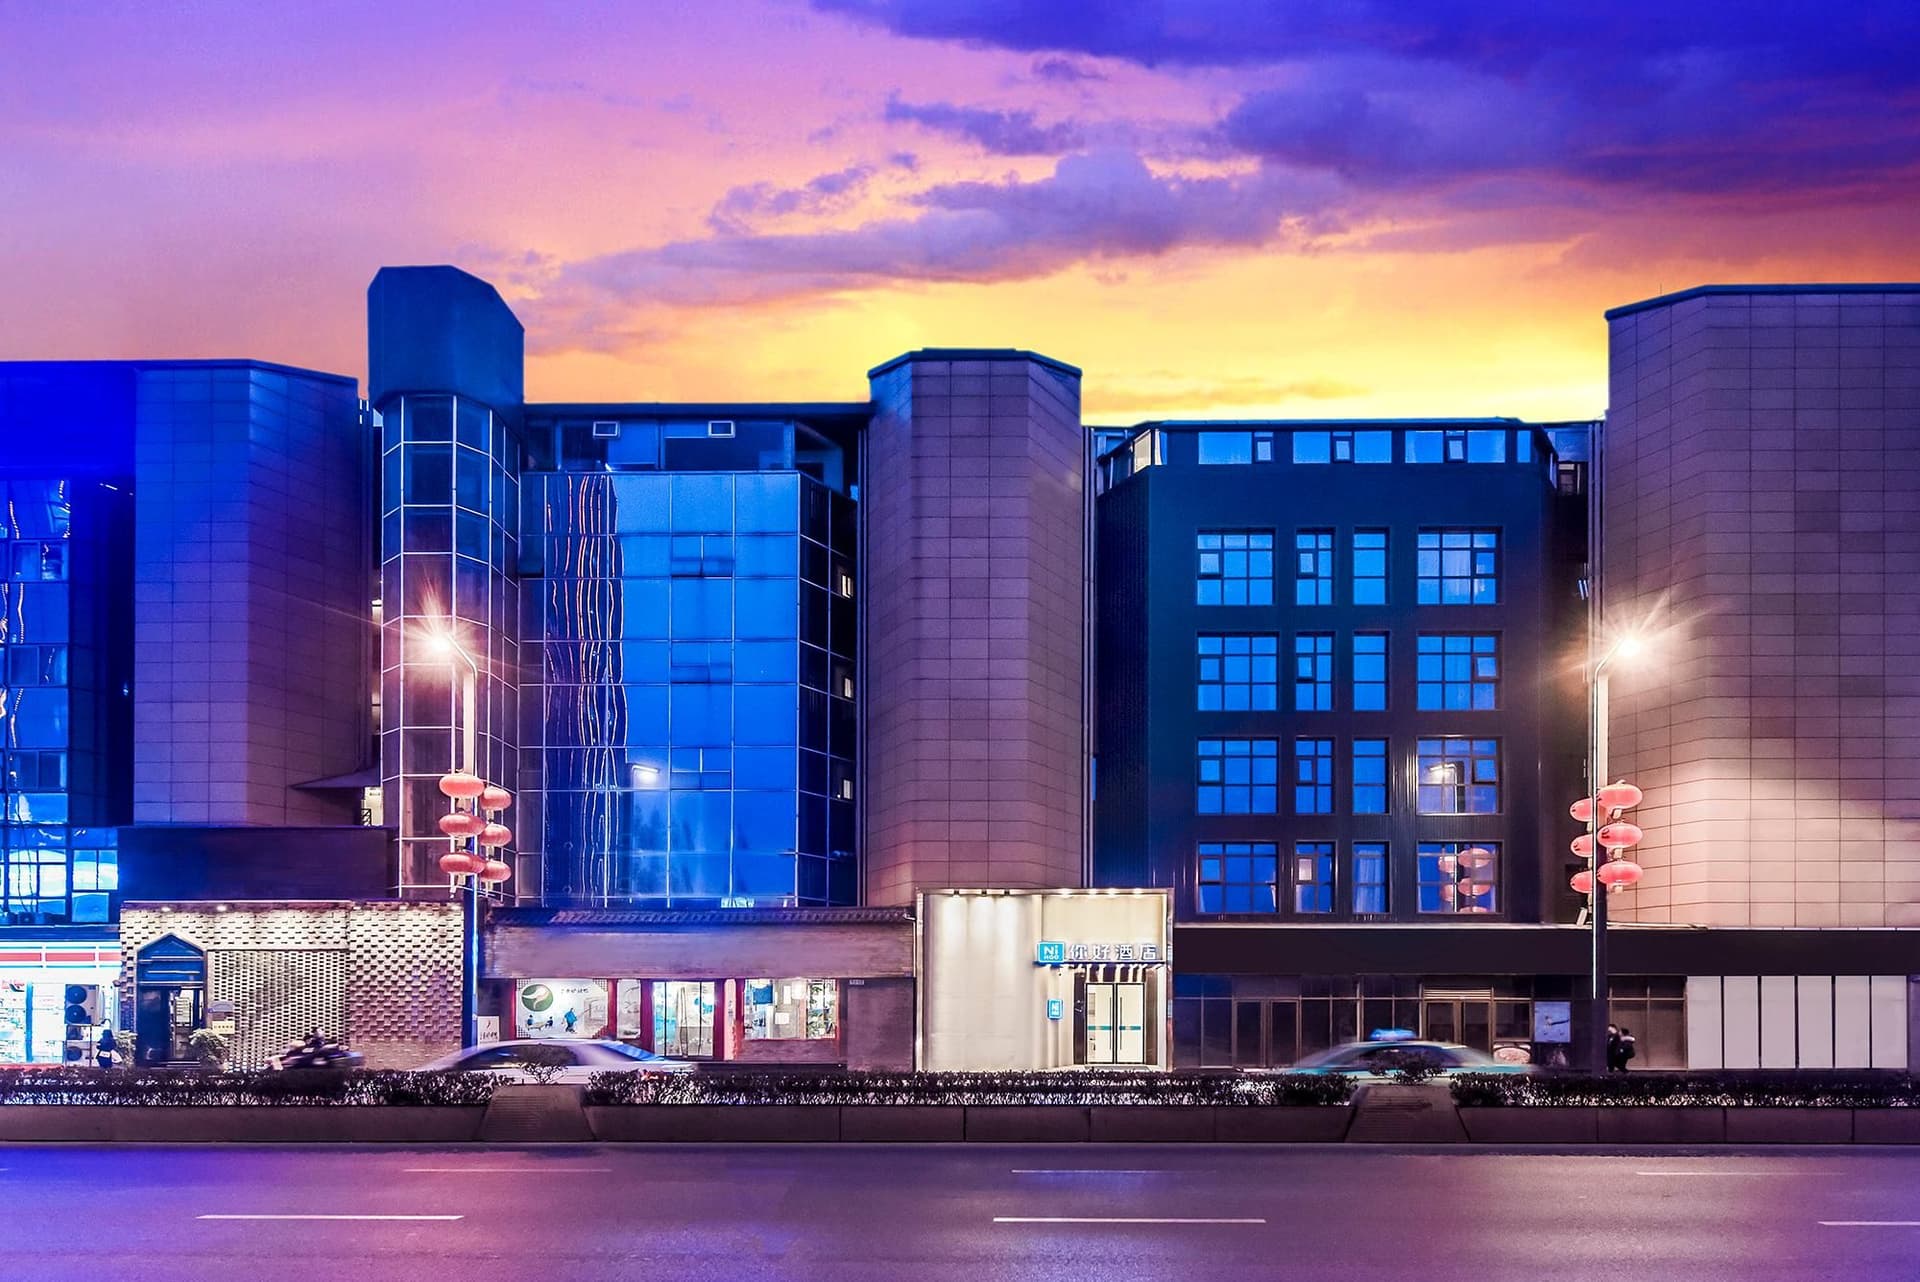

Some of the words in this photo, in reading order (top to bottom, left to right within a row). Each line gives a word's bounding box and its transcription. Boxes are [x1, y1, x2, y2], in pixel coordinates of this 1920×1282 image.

[1043, 945, 1058, 955] Ni
[1070, 944, 1157, 960] 你好酒店
